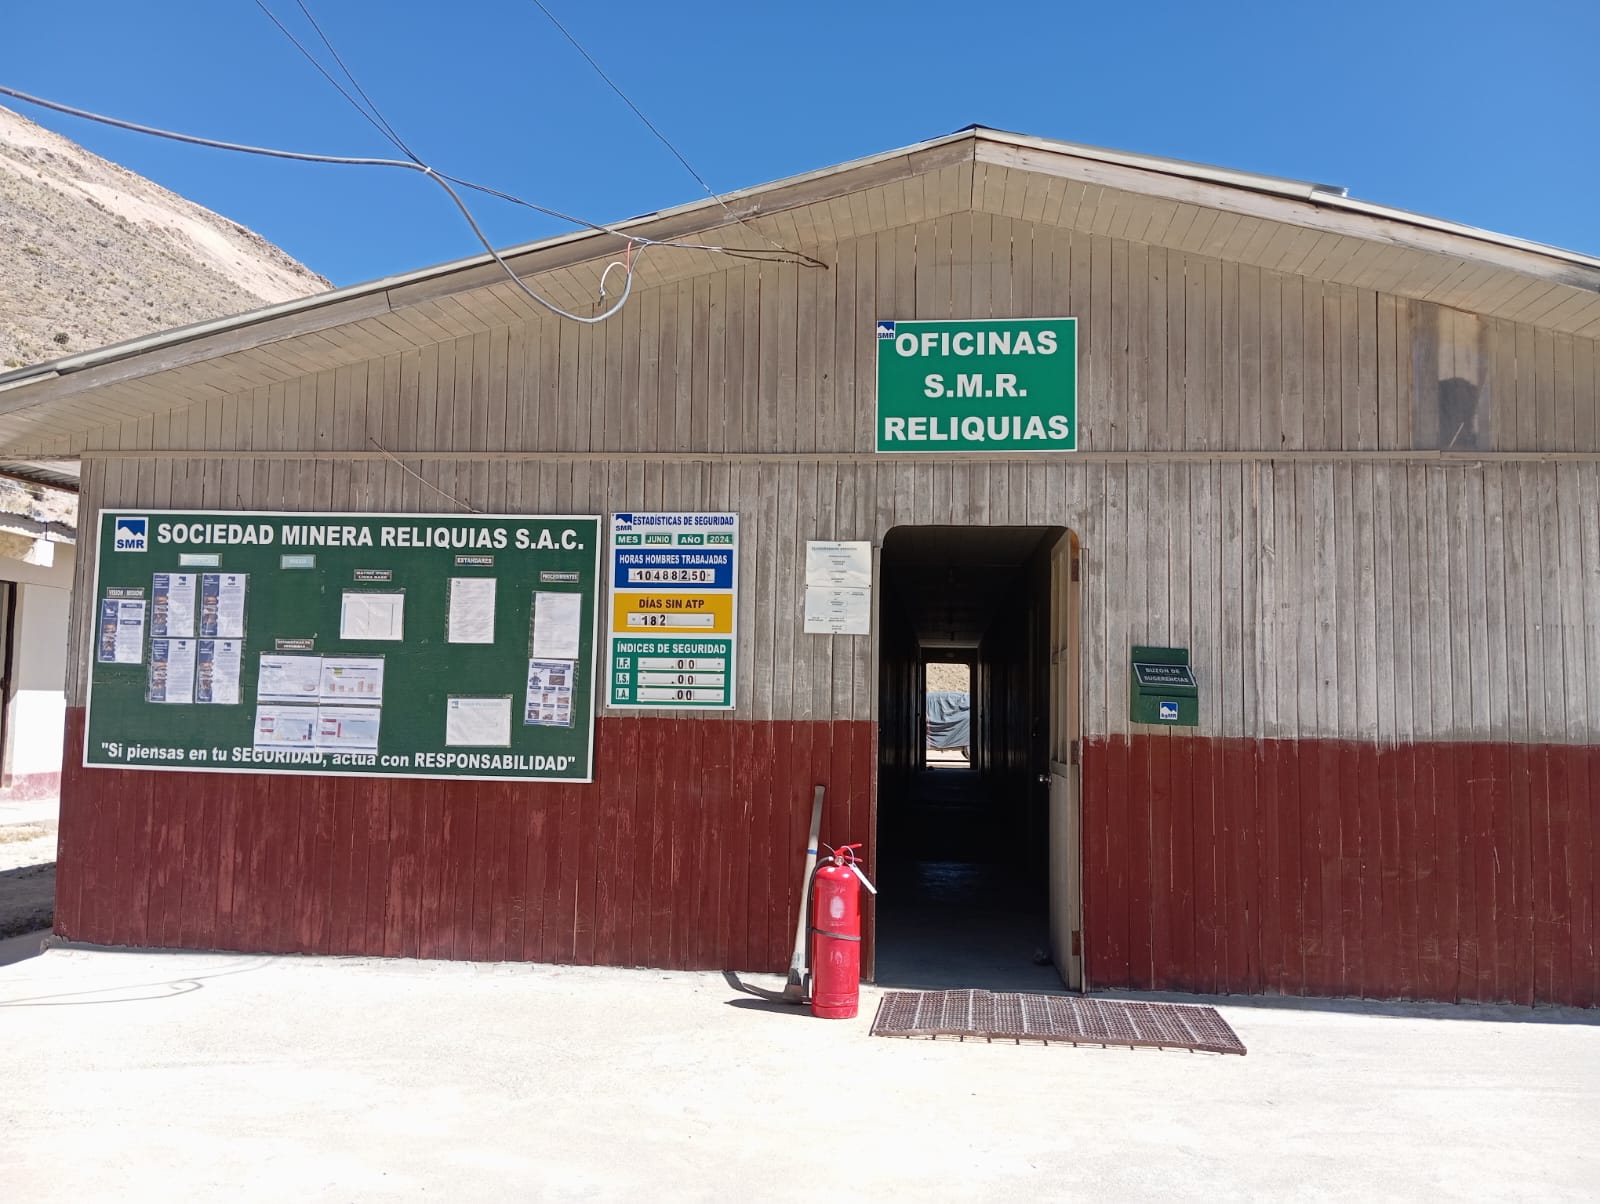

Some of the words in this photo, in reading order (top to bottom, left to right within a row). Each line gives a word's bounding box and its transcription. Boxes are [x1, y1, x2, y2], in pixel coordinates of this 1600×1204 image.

[895, 331, 1058, 357] OFICINAS
[924, 373, 1027, 398] S.M.R.
[885, 415, 1069, 442] RELIQUIAS
[633, 514, 682, 526] ESTADÍSTICAS
[683, 515, 693, 526] DE
[694, 515, 734, 526] SEGURIDAD
[157, 523, 275, 545] SOCIEDAD
[281, 525, 373, 546] MINERA
[380, 527, 508, 549] RELIQUIAS
[515, 529, 585, 550] S.A.C.
[618, 536, 639, 544] MES
[647, 535, 670, 544] JUNIO
[681, 534, 701, 544] AÑO
[710, 535, 730, 544] 2024
[116, 539, 144, 549] SMR
[619, 554, 644, 565] HORAS
[645, 554, 680, 565] HOMBRES
[681, 554, 728, 565] TRABAJADAS
[639, 597, 662, 608] DÍAS
[665, 599, 682, 608] SIN
[685, 600, 705, 608] ATP
[641, 615, 666, 626] 182
[617, 641, 654, 653] ÍNDICES
[657, 644, 670, 653] DE
[672, 644, 726, 654] SEGURIDAD
[617, 658, 629, 668] I.F.
[617, 674, 629, 683] I.S.
[616, 689, 629, 699] I.A.
[101, 742, 122, 758] "Si
[126, 746, 184, 761] piensas
[189, 749, 207, 761] en
[212, 747, 227, 761] tu
[232, 747, 327, 767] SEGURIDAD,
[332, 753, 376, 766] actua
[380, 754, 409, 767] con
[415, 753, 575, 771] RESPONSABILIDAD"
